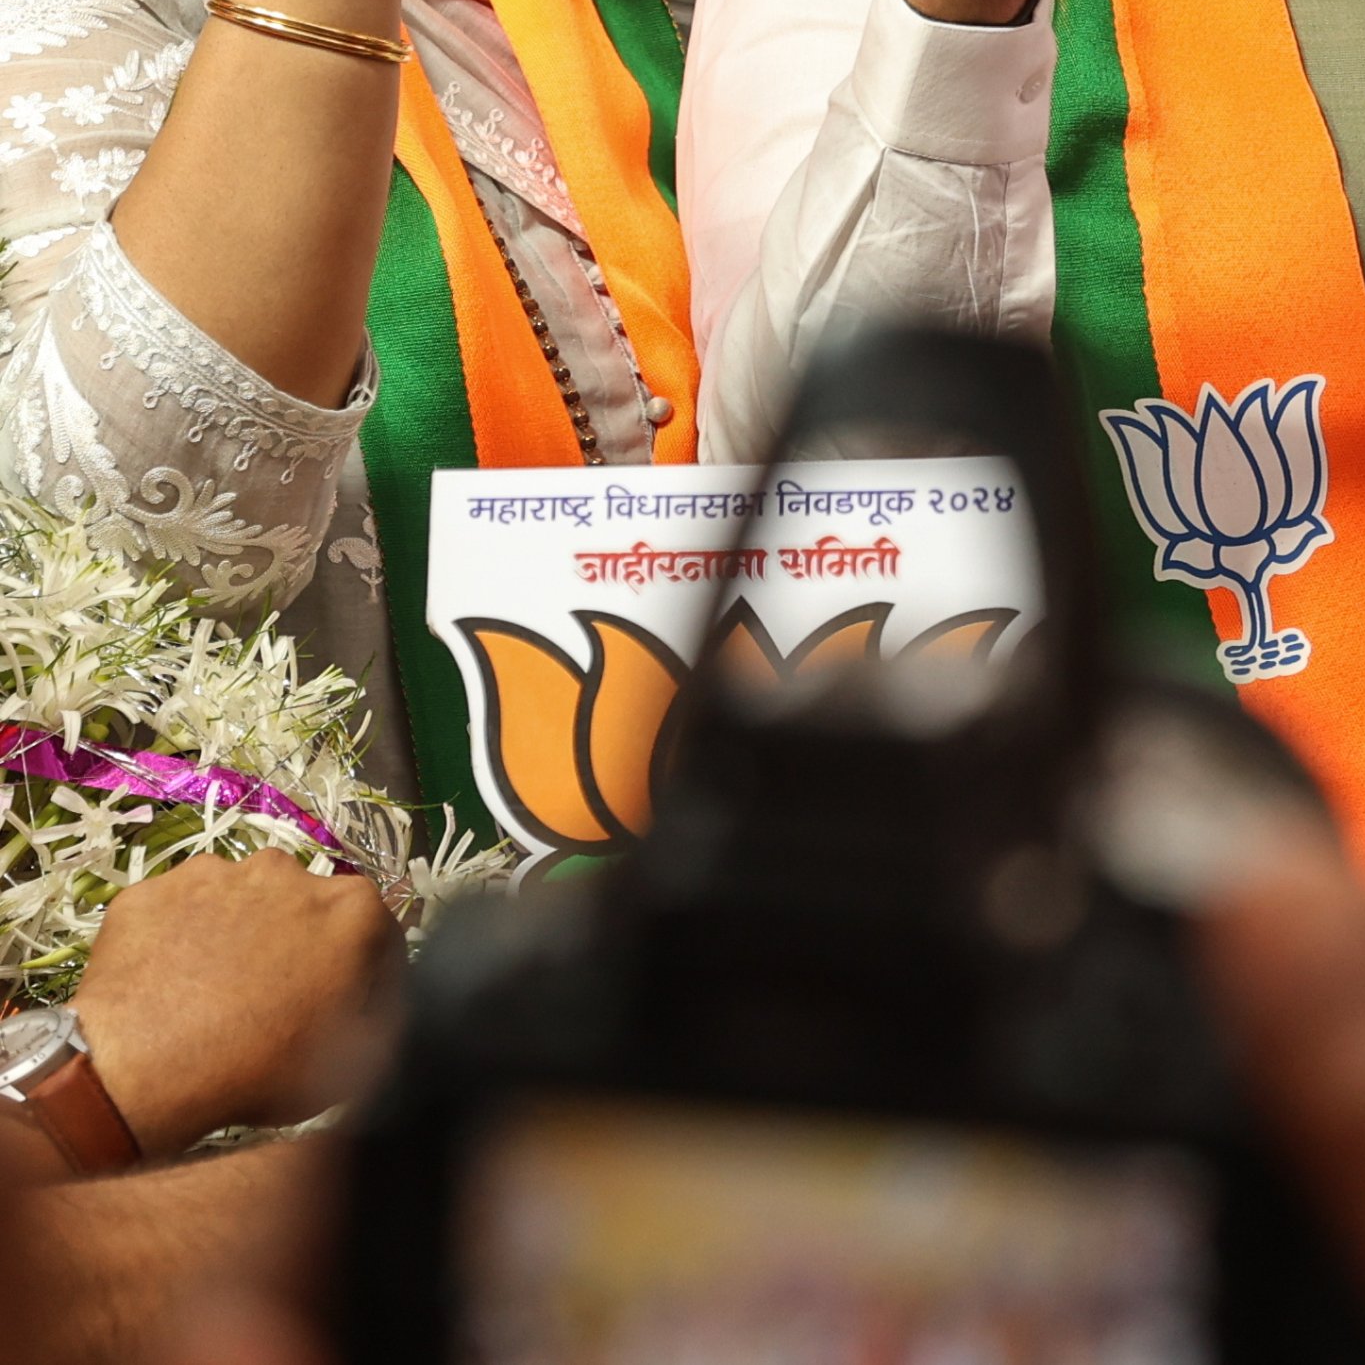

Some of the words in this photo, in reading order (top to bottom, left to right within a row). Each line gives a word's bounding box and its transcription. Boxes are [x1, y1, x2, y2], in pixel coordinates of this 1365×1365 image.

[467, 495, 595, 527] महाराष्ट्र
[604, 483, 767, 521] विधानसभा
[775, 479, 916, 526] निवडणूक
[928, 486, 1016, 514] २०२४
[573, 540, 769, 594] जाहीरनामा
[777, 535, 901, 583] समिती
